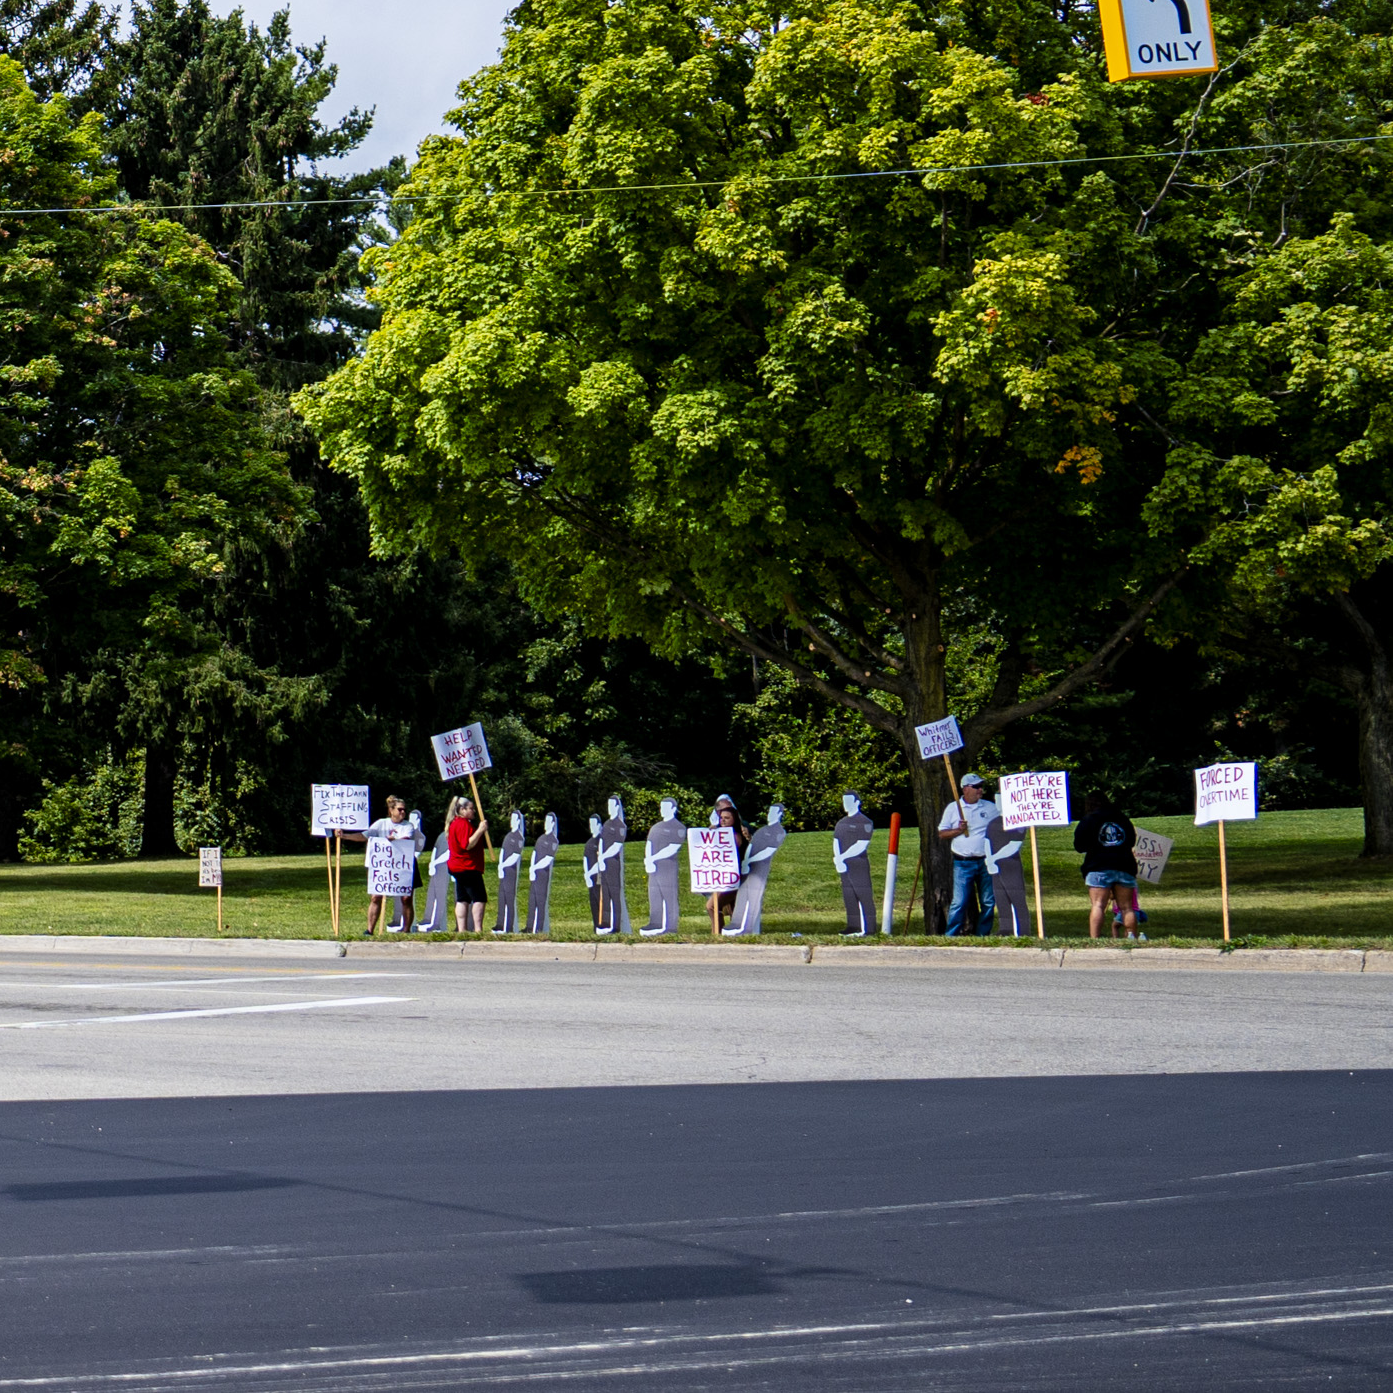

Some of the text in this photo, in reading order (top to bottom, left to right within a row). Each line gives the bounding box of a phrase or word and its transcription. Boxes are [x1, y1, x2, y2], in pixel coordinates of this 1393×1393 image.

[1138, 40, 1202, 64] ONLY
[444, 729, 472, 746] HELP
[931, 729, 954, 743] FAILS
[440, 744, 482, 764] WANTED
[446, 757, 485, 777] NEEDED
[1003, 777, 1012, 790] IF
[1199, 766, 1244, 791] FORCED
[1010, 787, 1064, 804] NOT HERE
[1199, 787, 1250, 808] OVERTIME
[700, 831, 730, 844] WE
[374, 842, 393, 858] Big
[701, 850, 734, 863] ARE
[371, 854, 411, 870] Gretch
[373, 869, 400, 882] Fails
[693, 869, 740, 885] TIRED
